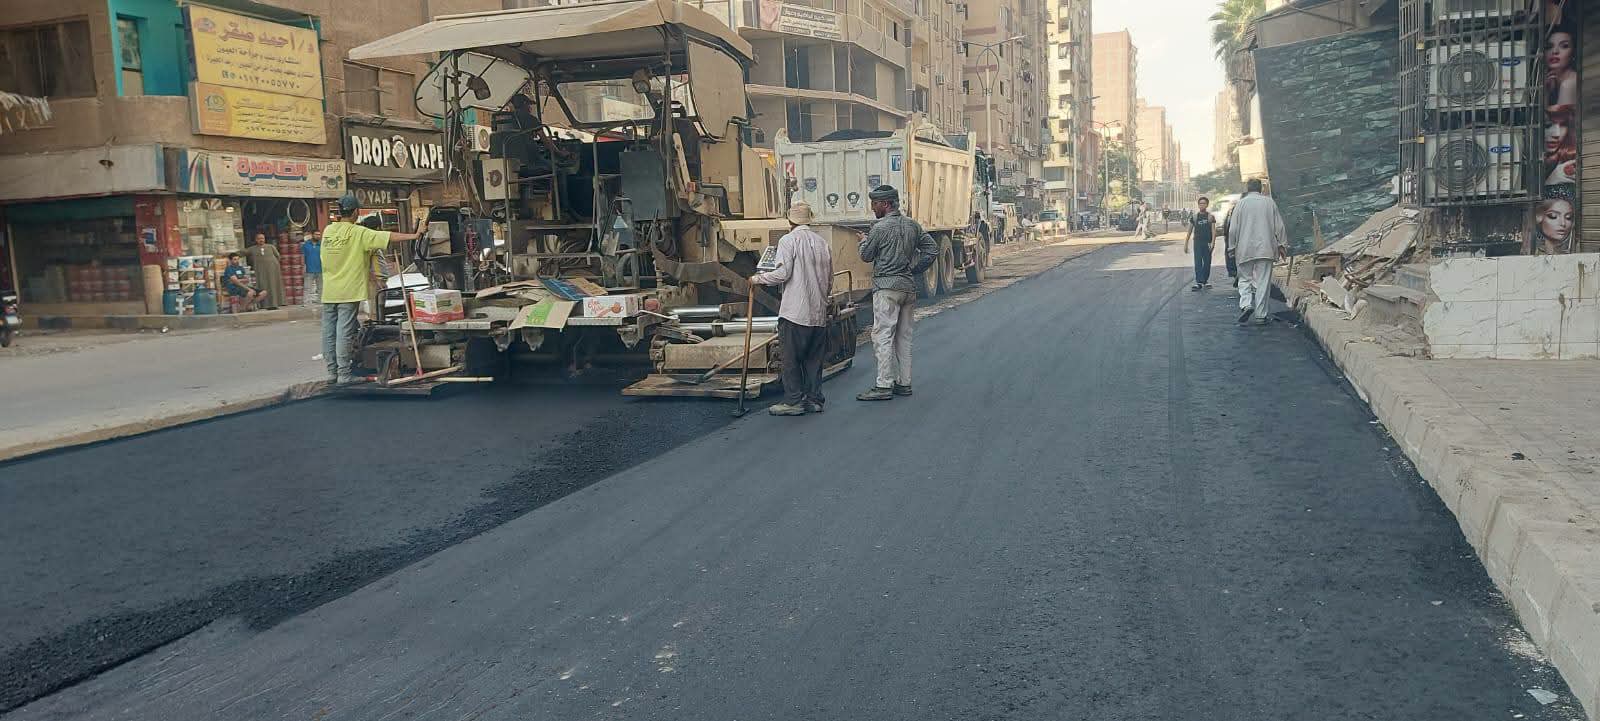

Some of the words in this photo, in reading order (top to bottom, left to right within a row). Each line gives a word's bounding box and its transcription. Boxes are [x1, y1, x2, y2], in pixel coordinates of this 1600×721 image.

[351, 135, 391, 167] DROP
[409, 142, 444, 170] VAPE
[366, 189, 393, 204] VAPE
